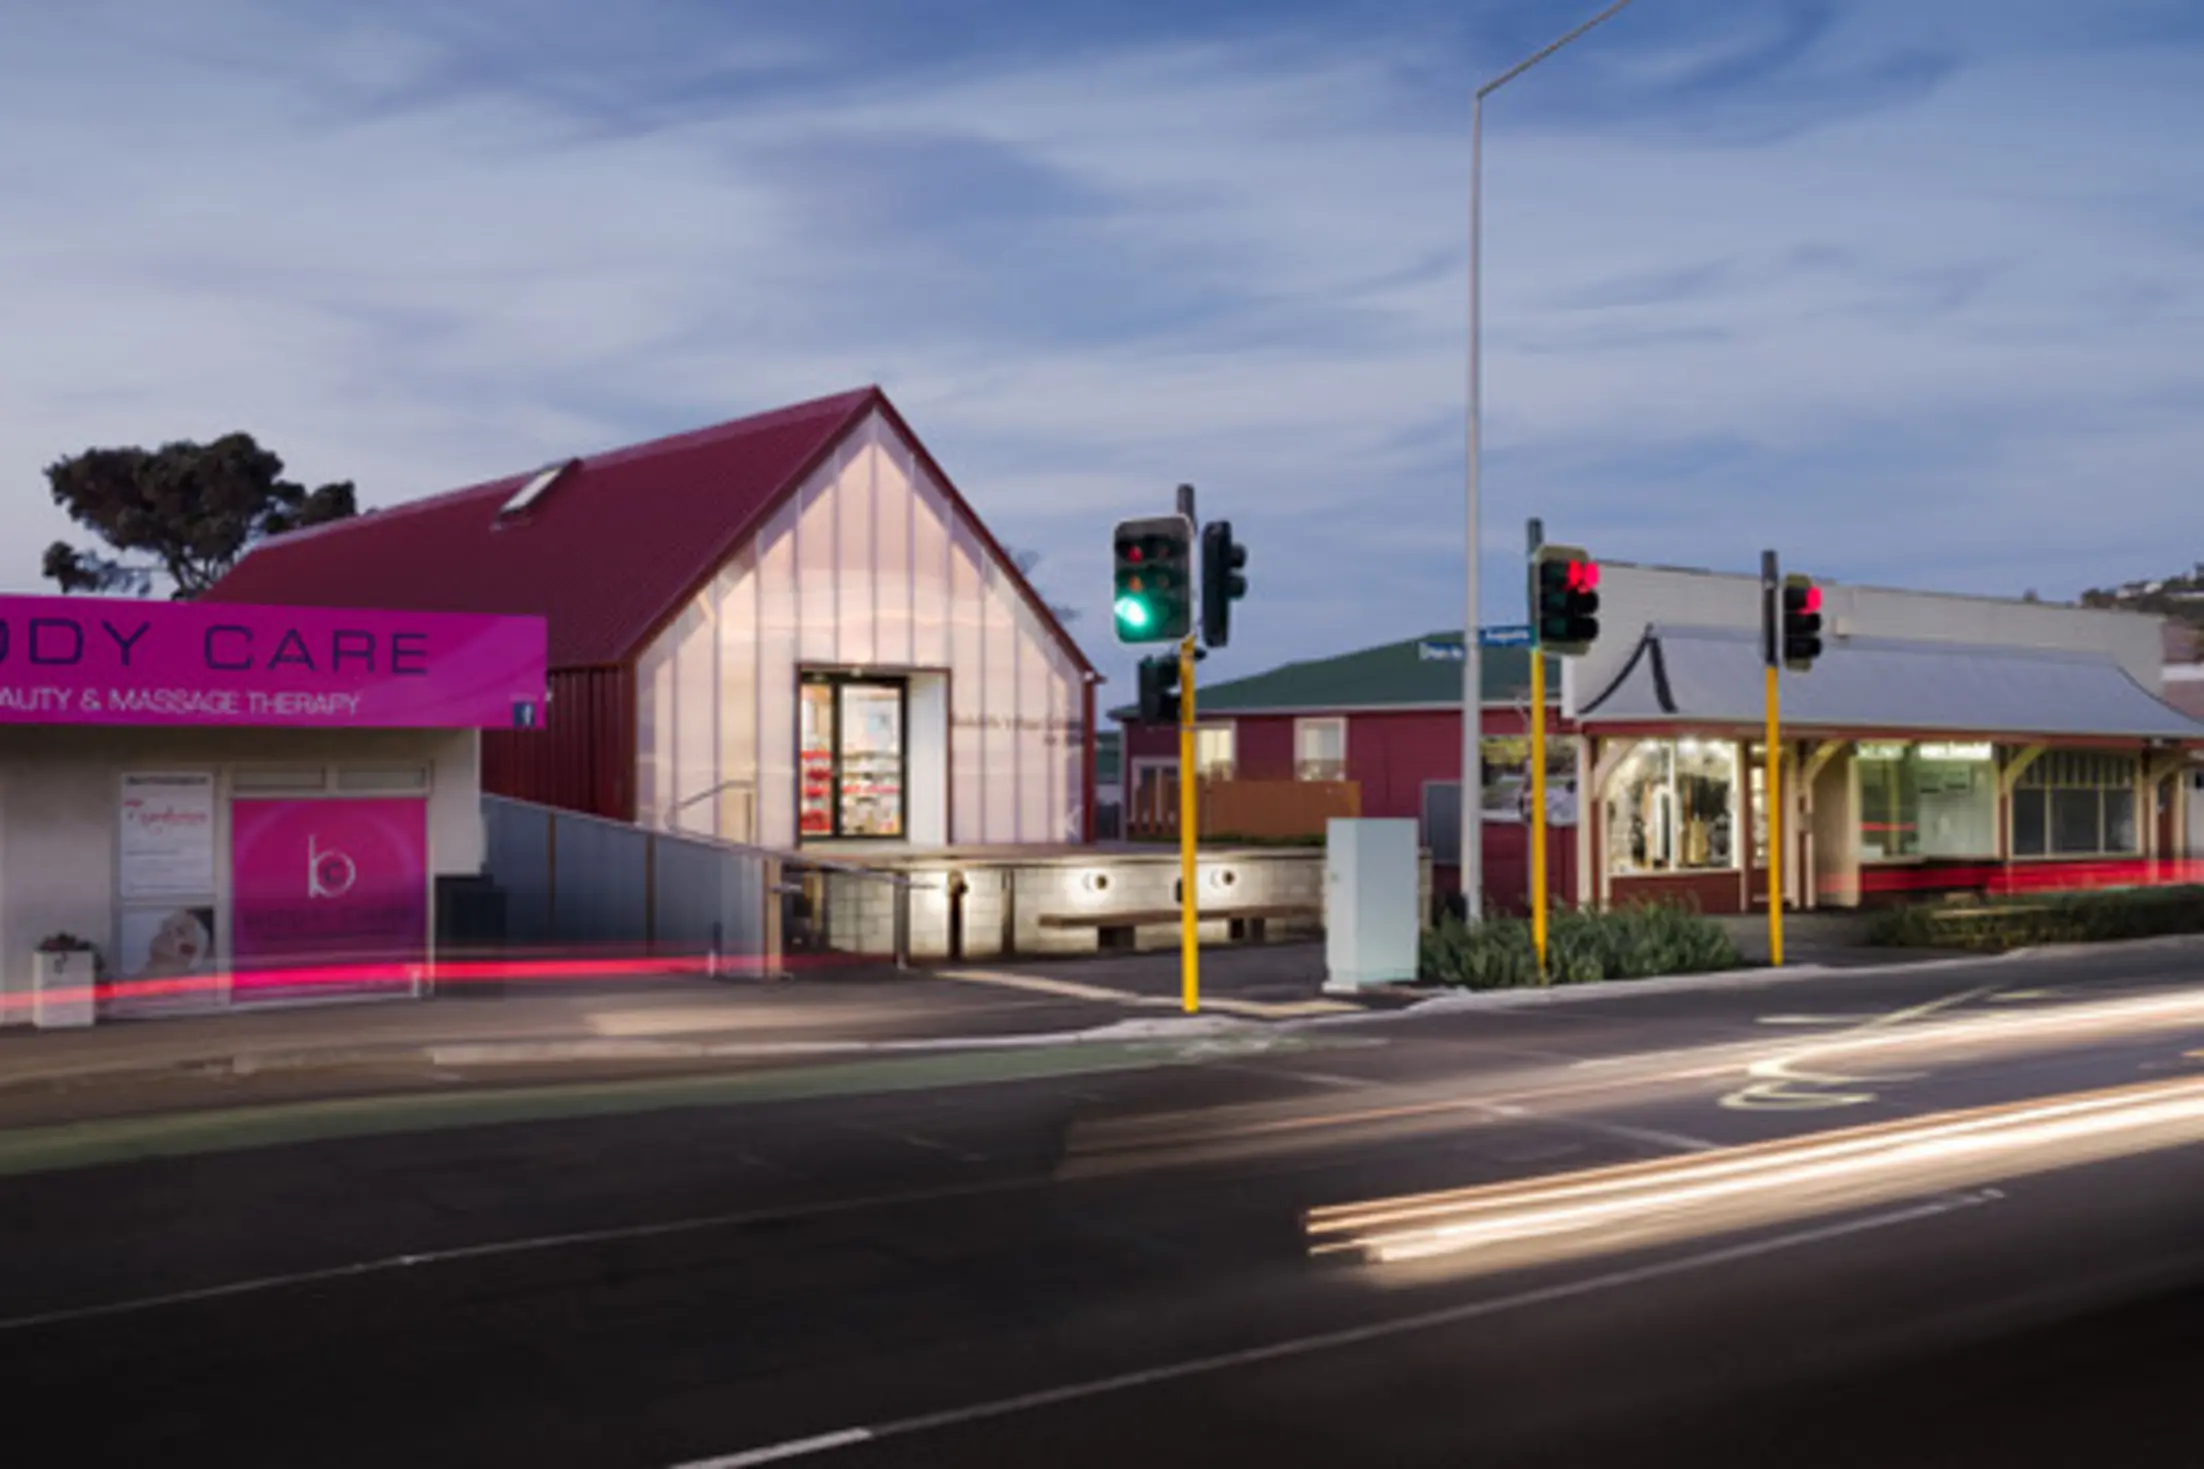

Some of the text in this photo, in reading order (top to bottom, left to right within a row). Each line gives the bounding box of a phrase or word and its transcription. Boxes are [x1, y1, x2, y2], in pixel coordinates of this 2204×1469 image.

[203, 624, 430, 676] CARE
[79, 687, 103, 712] &
[107, 687, 241, 716] MASSAGE
[247, 689, 362, 717] THERAPY
